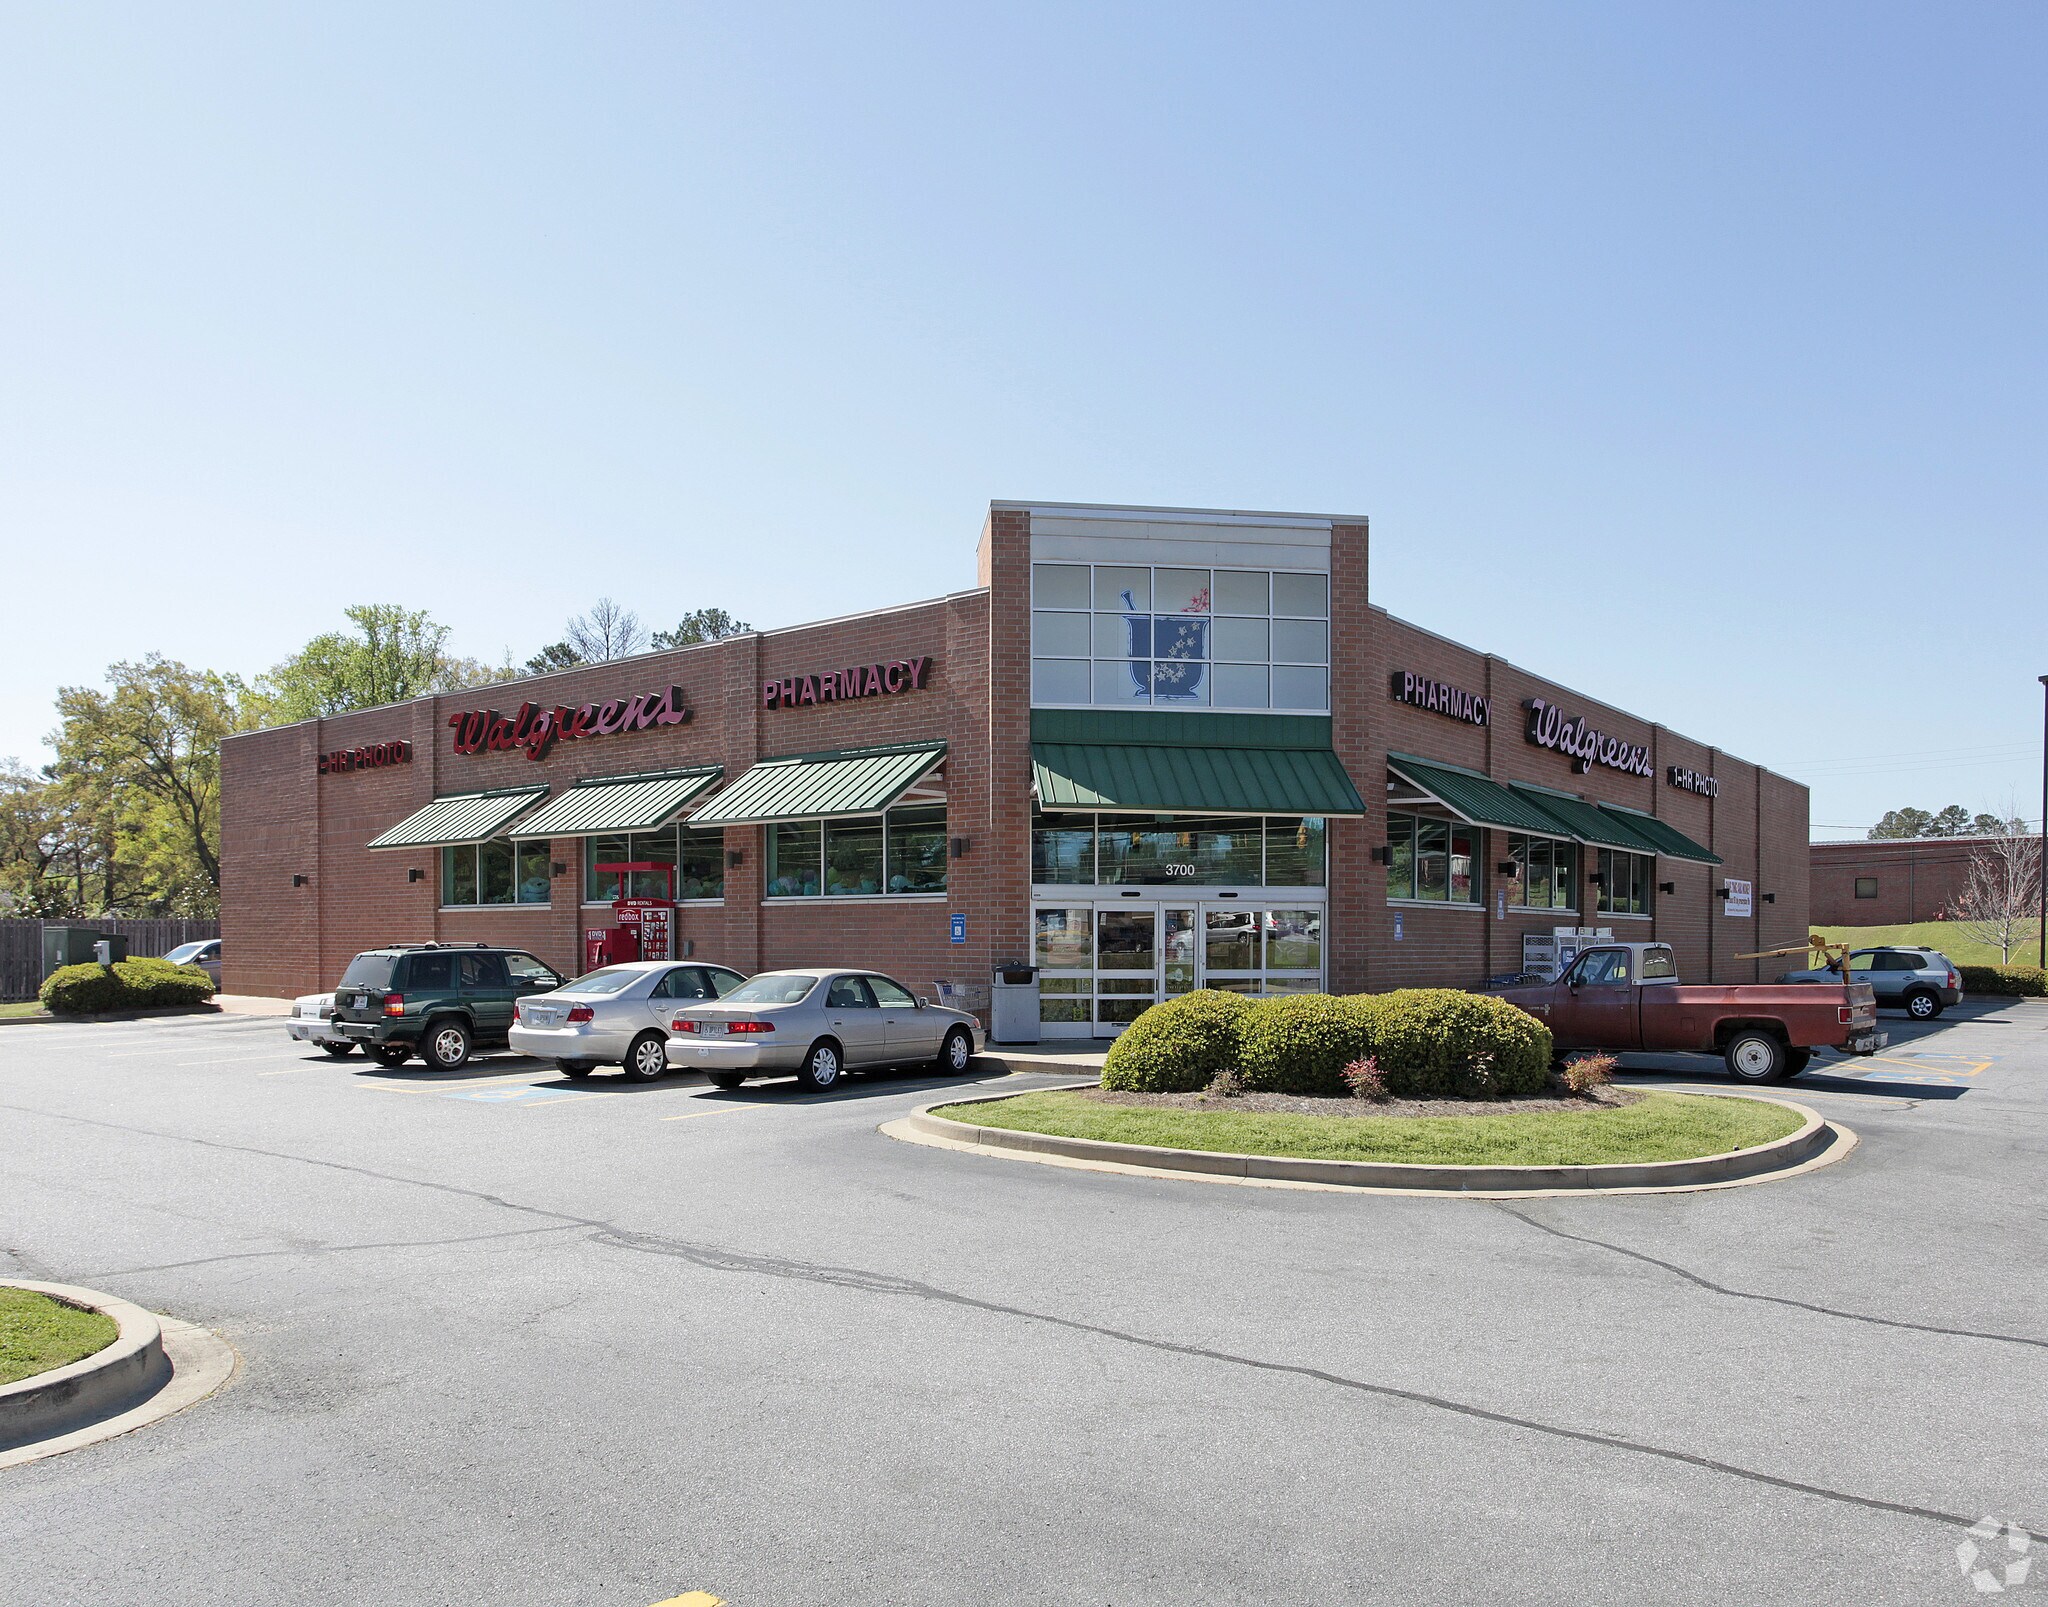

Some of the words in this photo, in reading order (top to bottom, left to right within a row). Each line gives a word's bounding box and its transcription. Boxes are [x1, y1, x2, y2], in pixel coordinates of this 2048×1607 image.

[763, 656, 927, 709] PHARMACY
[1404, 671, 1492, 726] PHARMACY
[448, 684, 685, 761] Walgreens
[1532, 697, 1654, 778] Walgreens
[354, 740, 405, 768] PHOTO
[1674, 766, 1693, 791] 1-HR
[1695, 772, 1718, 798] PHOTO
[1165, 864, 1195, 876] 3700
[619, 912, 639, 921] redbox
